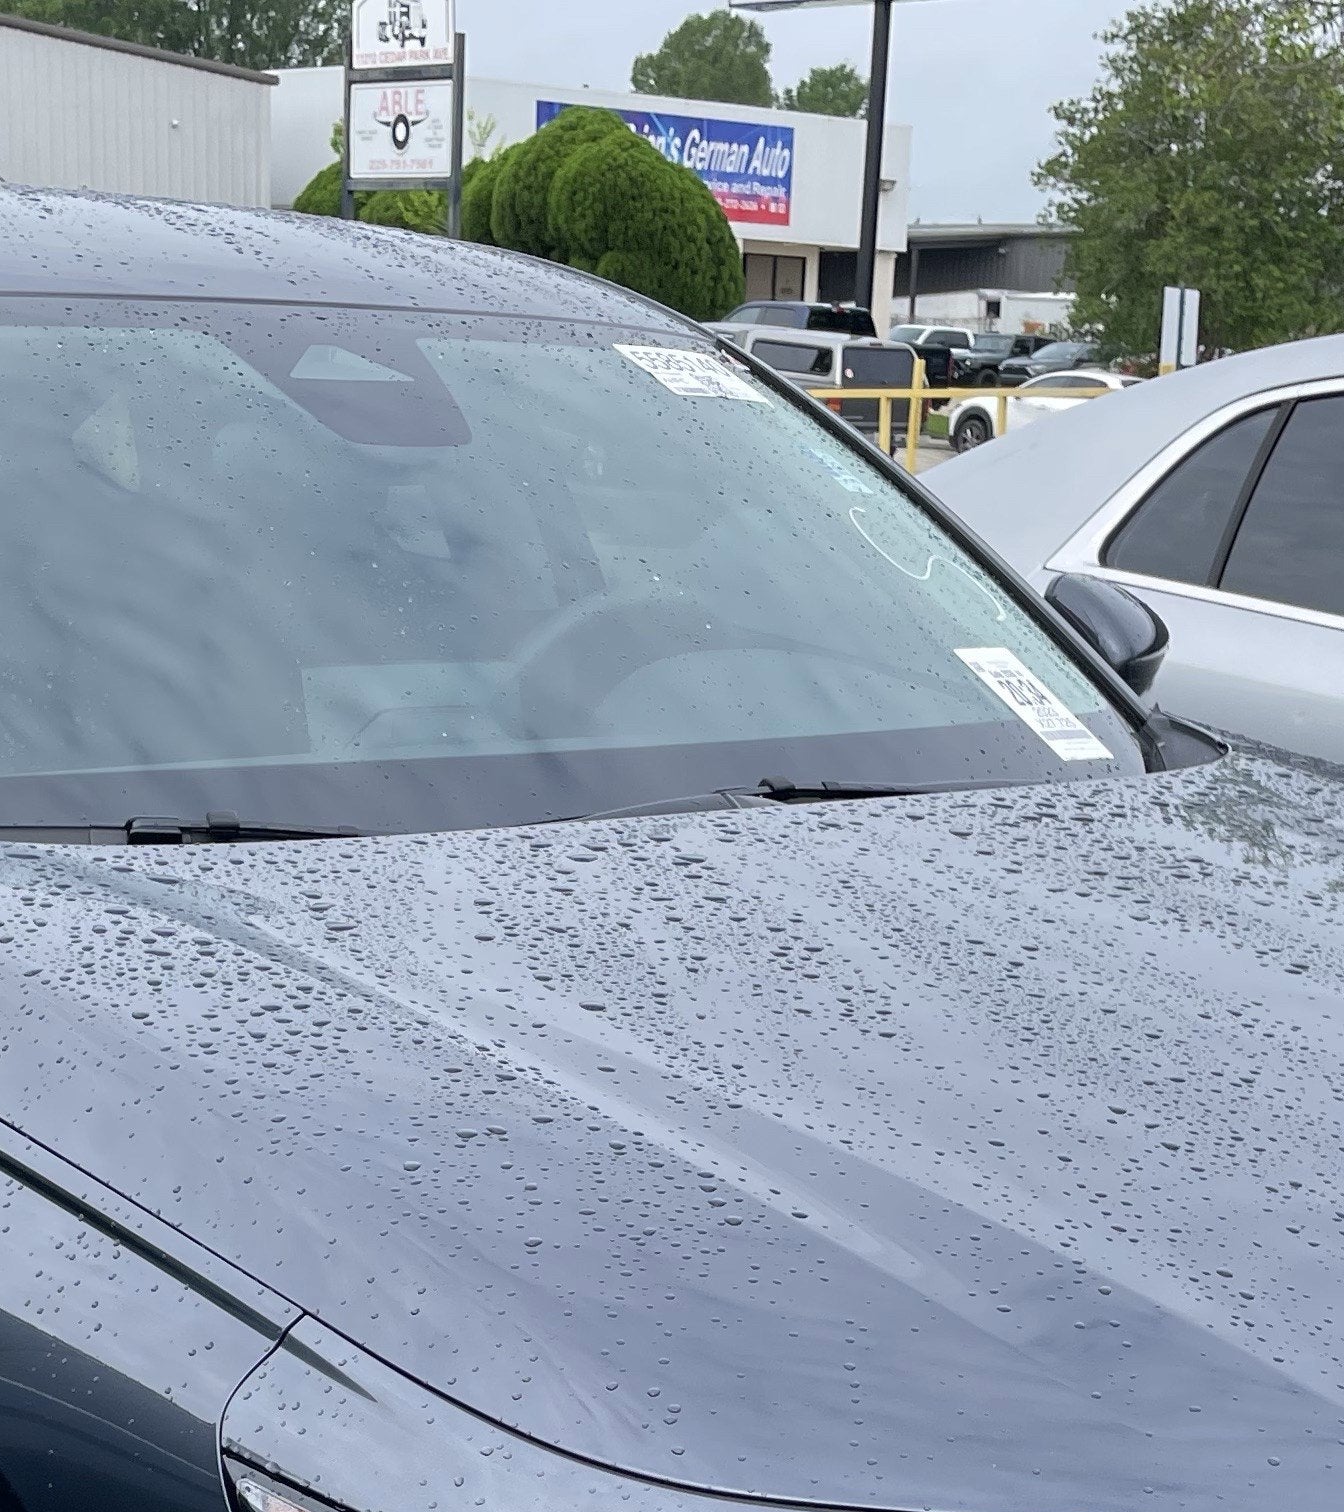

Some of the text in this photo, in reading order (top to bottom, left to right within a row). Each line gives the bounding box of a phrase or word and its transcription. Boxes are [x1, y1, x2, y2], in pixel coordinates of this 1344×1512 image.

[379, 89, 426, 116] ABLE
[683, 128, 747, 174] German
[749, 136, 790, 178] Auto
